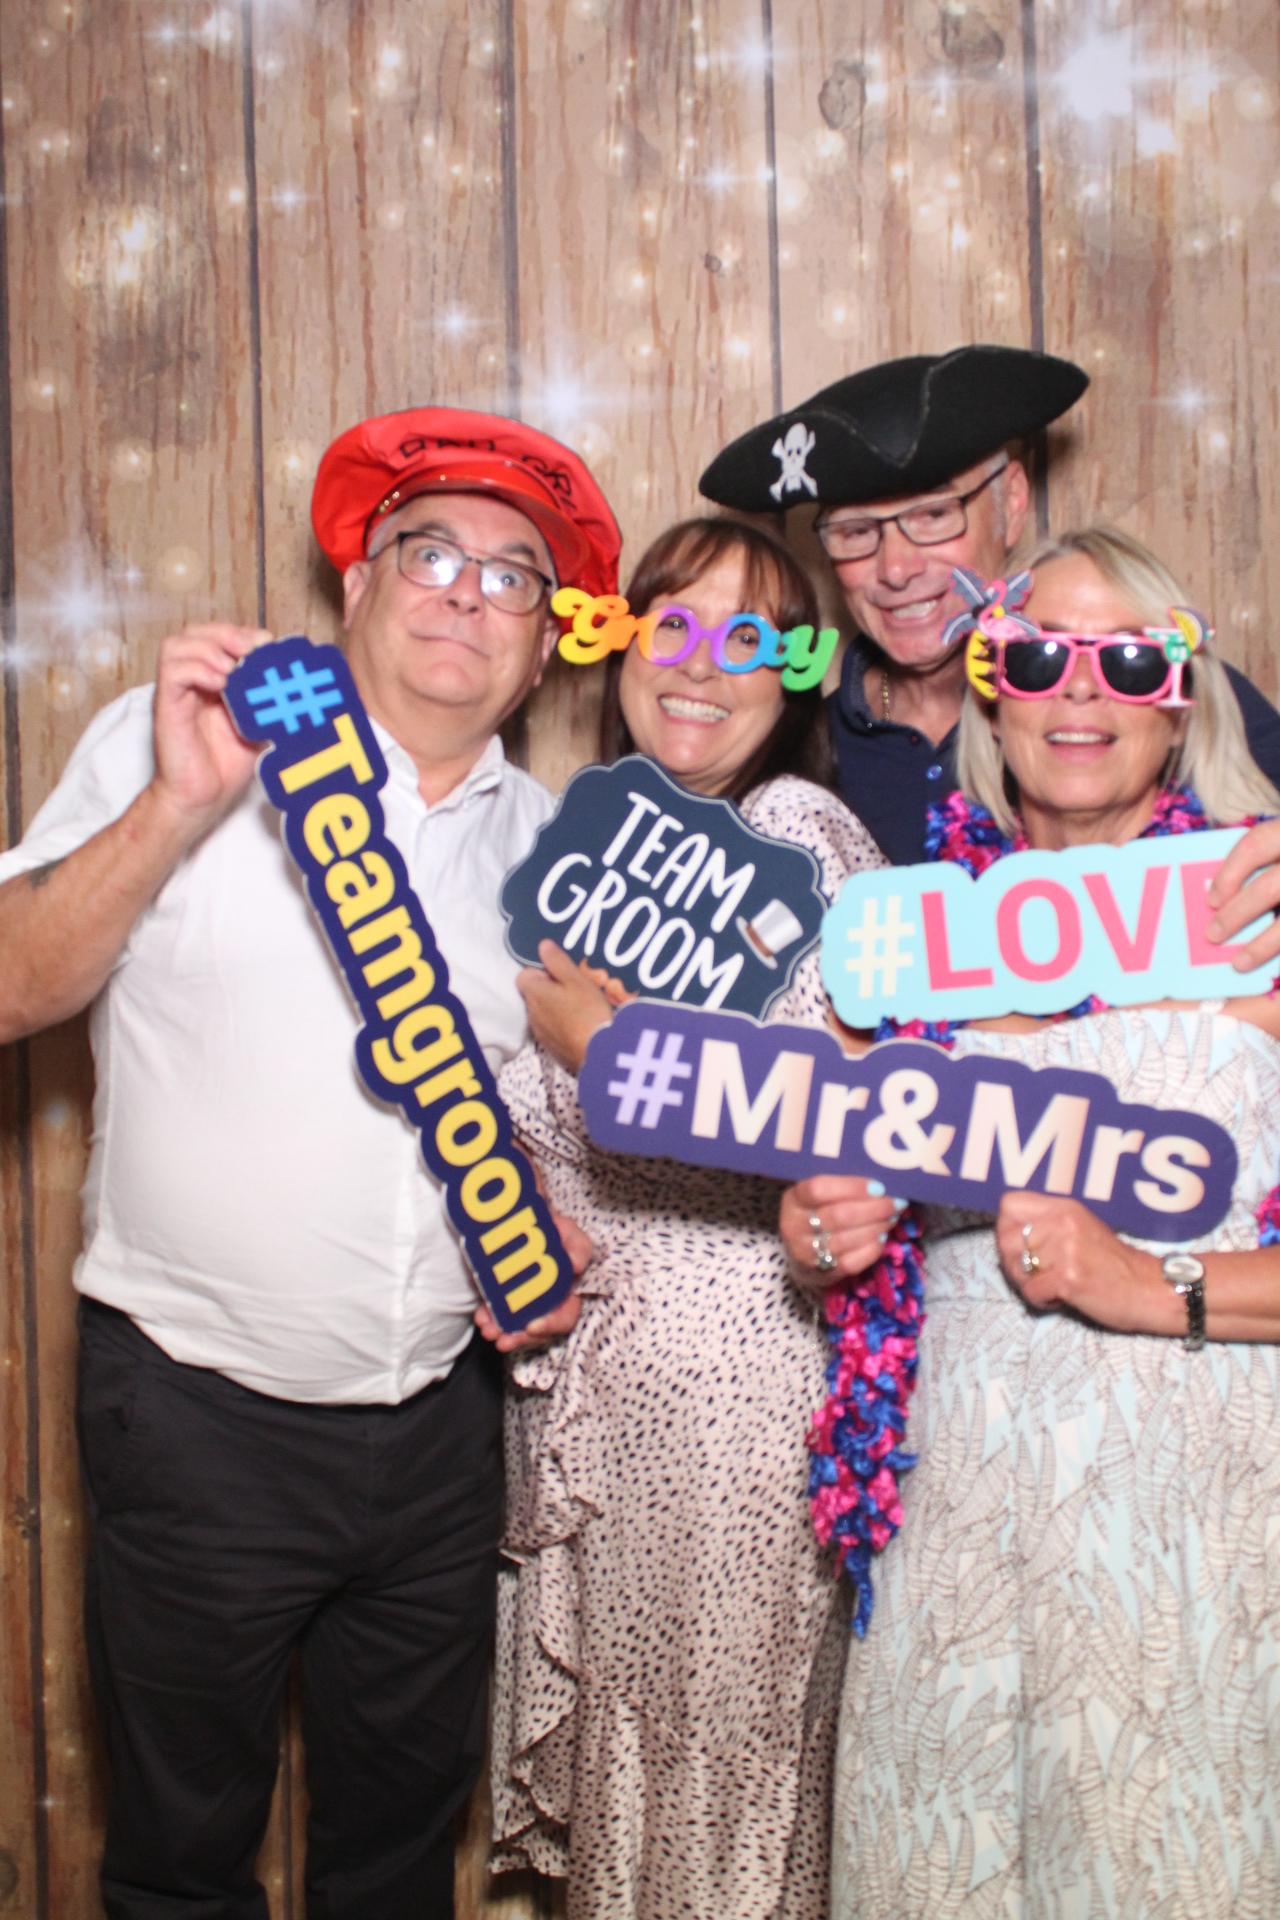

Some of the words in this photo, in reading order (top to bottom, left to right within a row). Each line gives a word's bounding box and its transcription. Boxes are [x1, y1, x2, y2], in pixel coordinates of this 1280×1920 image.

[537, 853, 745, 1011] GROOM
[601, 791, 756, 933] TEAM
[845, 858, 1257, 999] #LOVE
[245, 660, 560, 1314] #Teamgroom
[607, 1028, 1212, 1213] #Mr&Mrs
